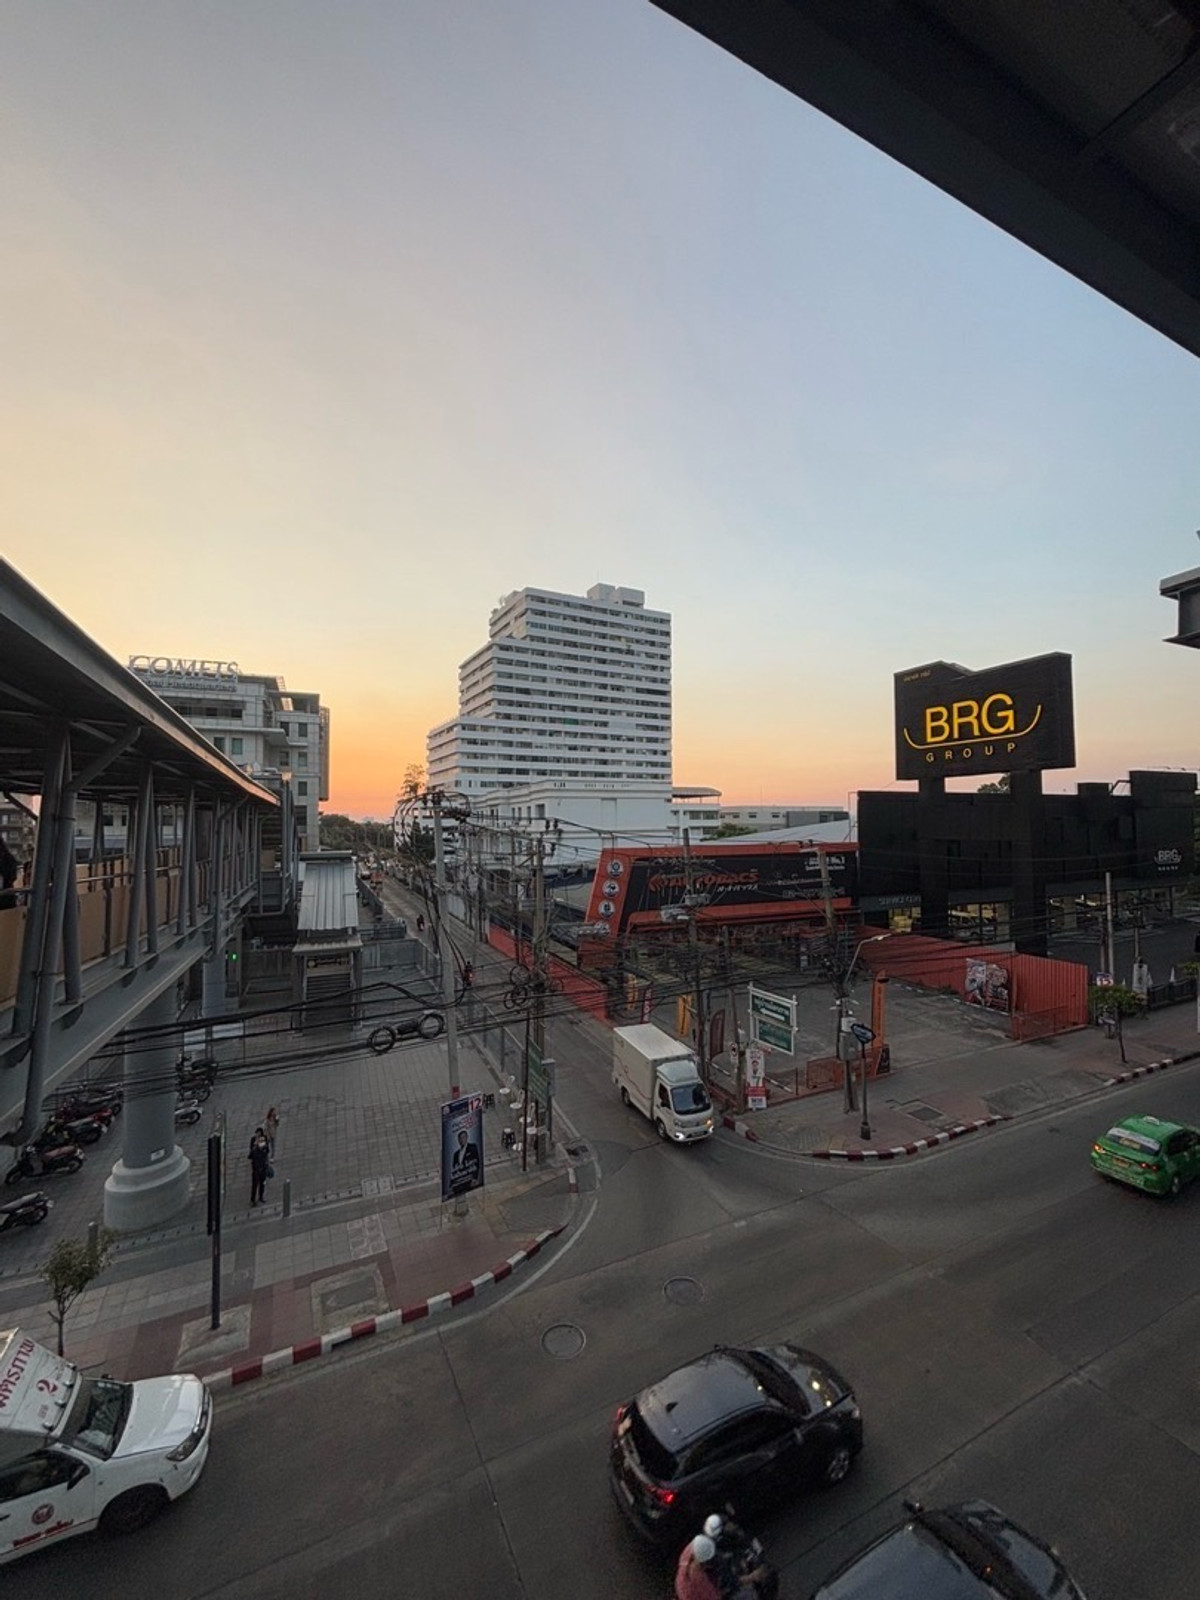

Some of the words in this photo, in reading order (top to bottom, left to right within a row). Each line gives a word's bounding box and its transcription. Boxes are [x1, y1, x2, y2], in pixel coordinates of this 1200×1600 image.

[128, 655, 238, 683] COMETS
[925, 693, 1015, 743] BRG
[926, 742, 1016, 762] GROUP
[36, 1379, 58, 1396] 2
